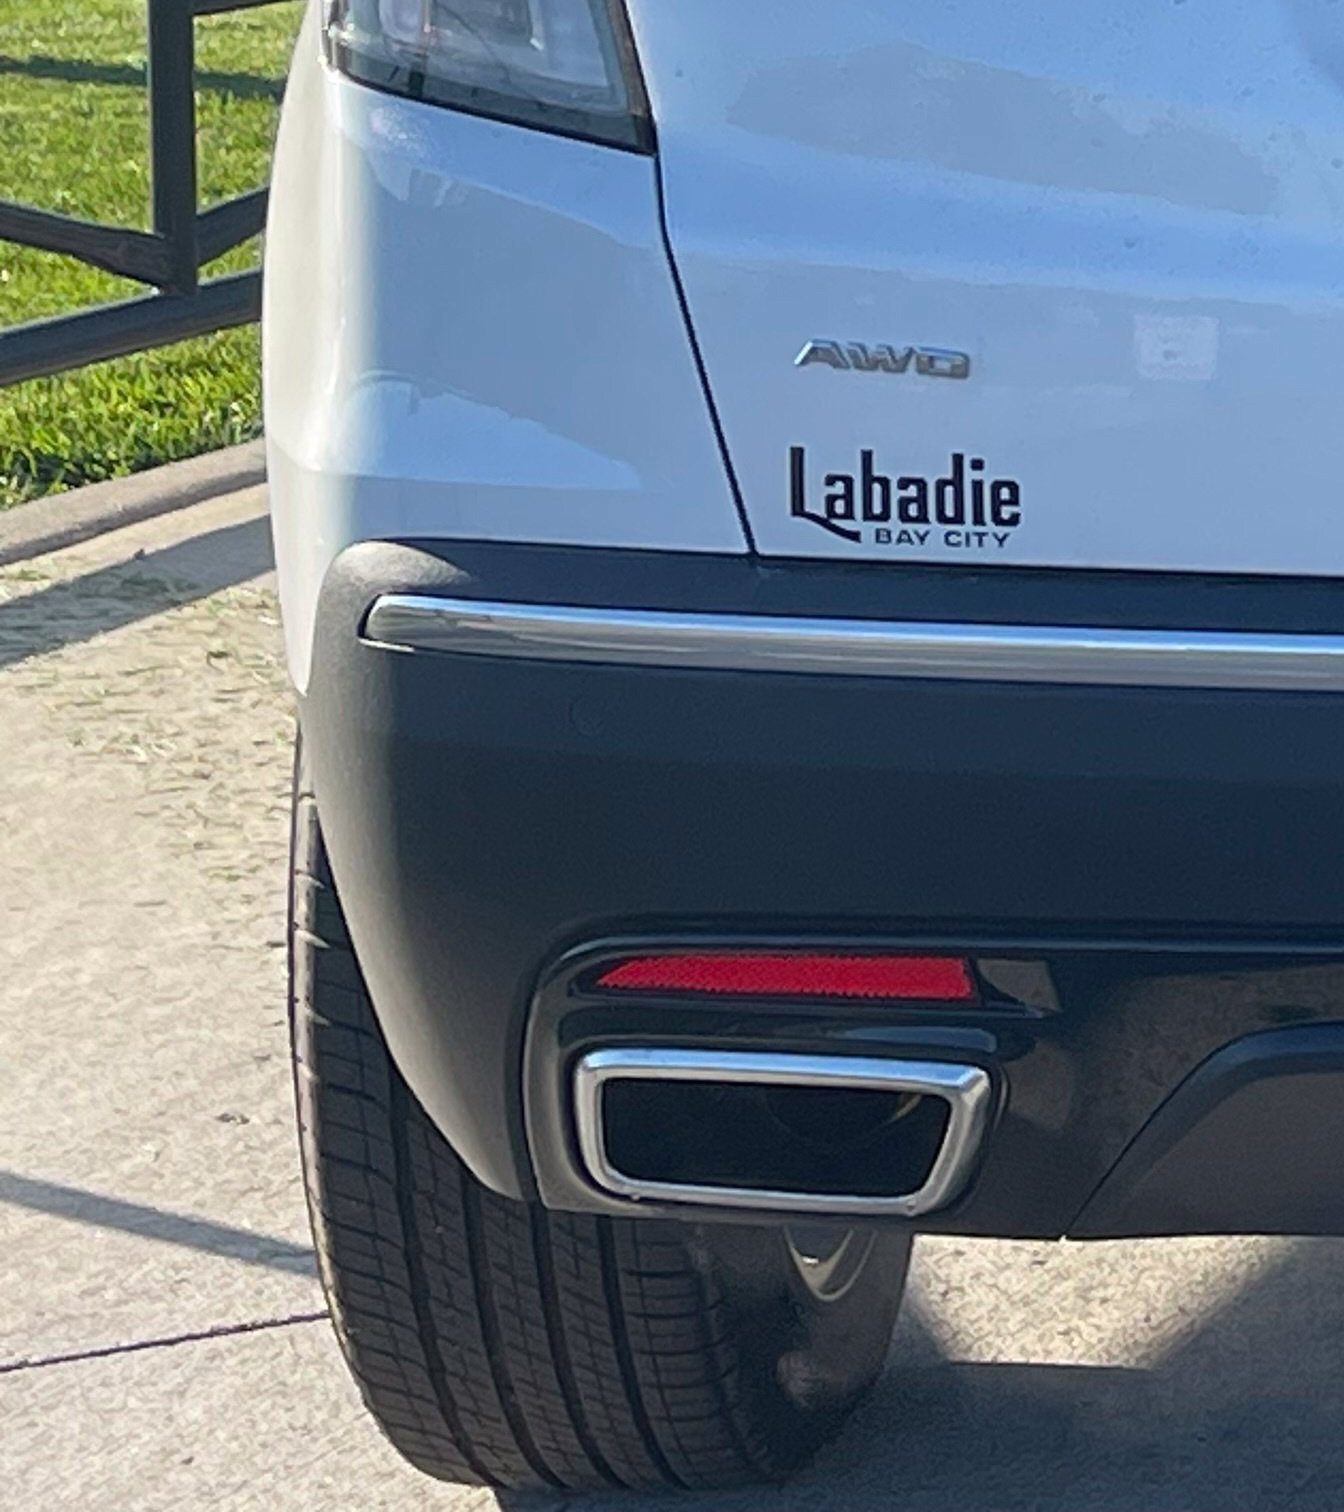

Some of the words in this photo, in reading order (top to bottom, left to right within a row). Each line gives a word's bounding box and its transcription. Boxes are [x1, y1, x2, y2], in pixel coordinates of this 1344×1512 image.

[795, 338, 970, 379] AWD
[789, 445, 1022, 543] Labadie
[874, 527, 930, 546] BAY
[942, 531, 1011, 548] CITY
